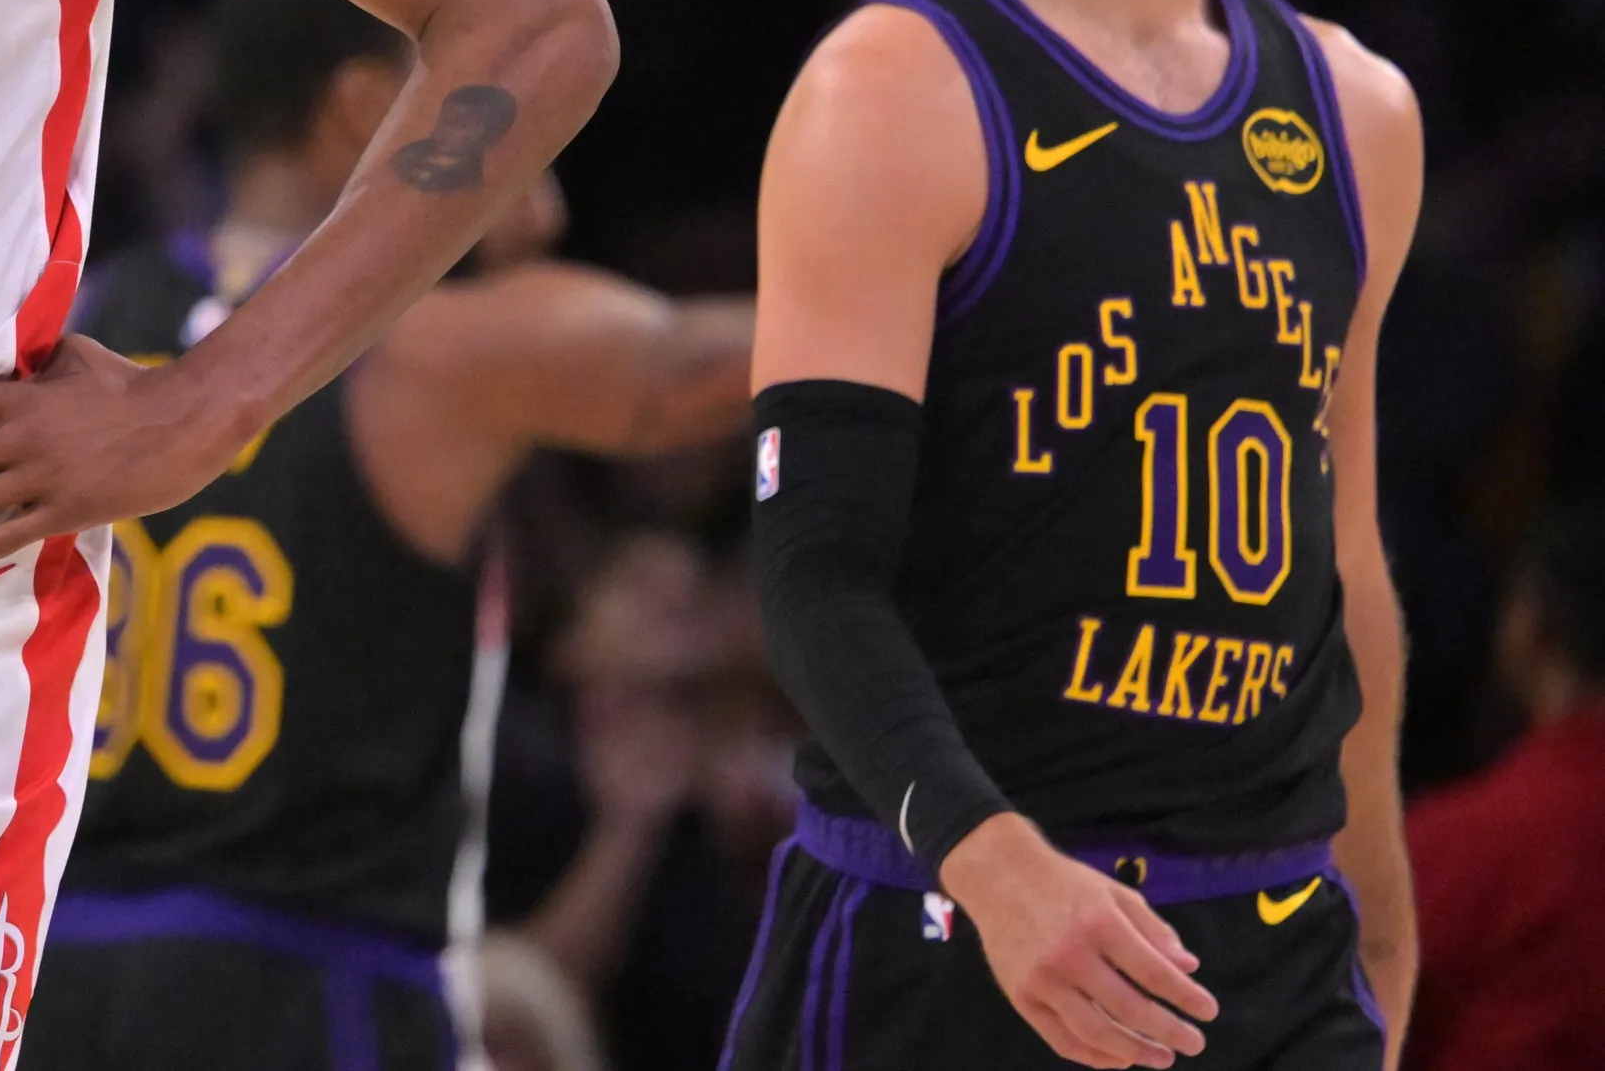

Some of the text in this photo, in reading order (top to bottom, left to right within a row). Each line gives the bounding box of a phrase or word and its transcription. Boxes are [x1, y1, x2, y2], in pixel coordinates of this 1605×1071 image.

[1013, 181, 1341, 475] LOS ANGEL
[1126, 393, 1293, 605] 10
